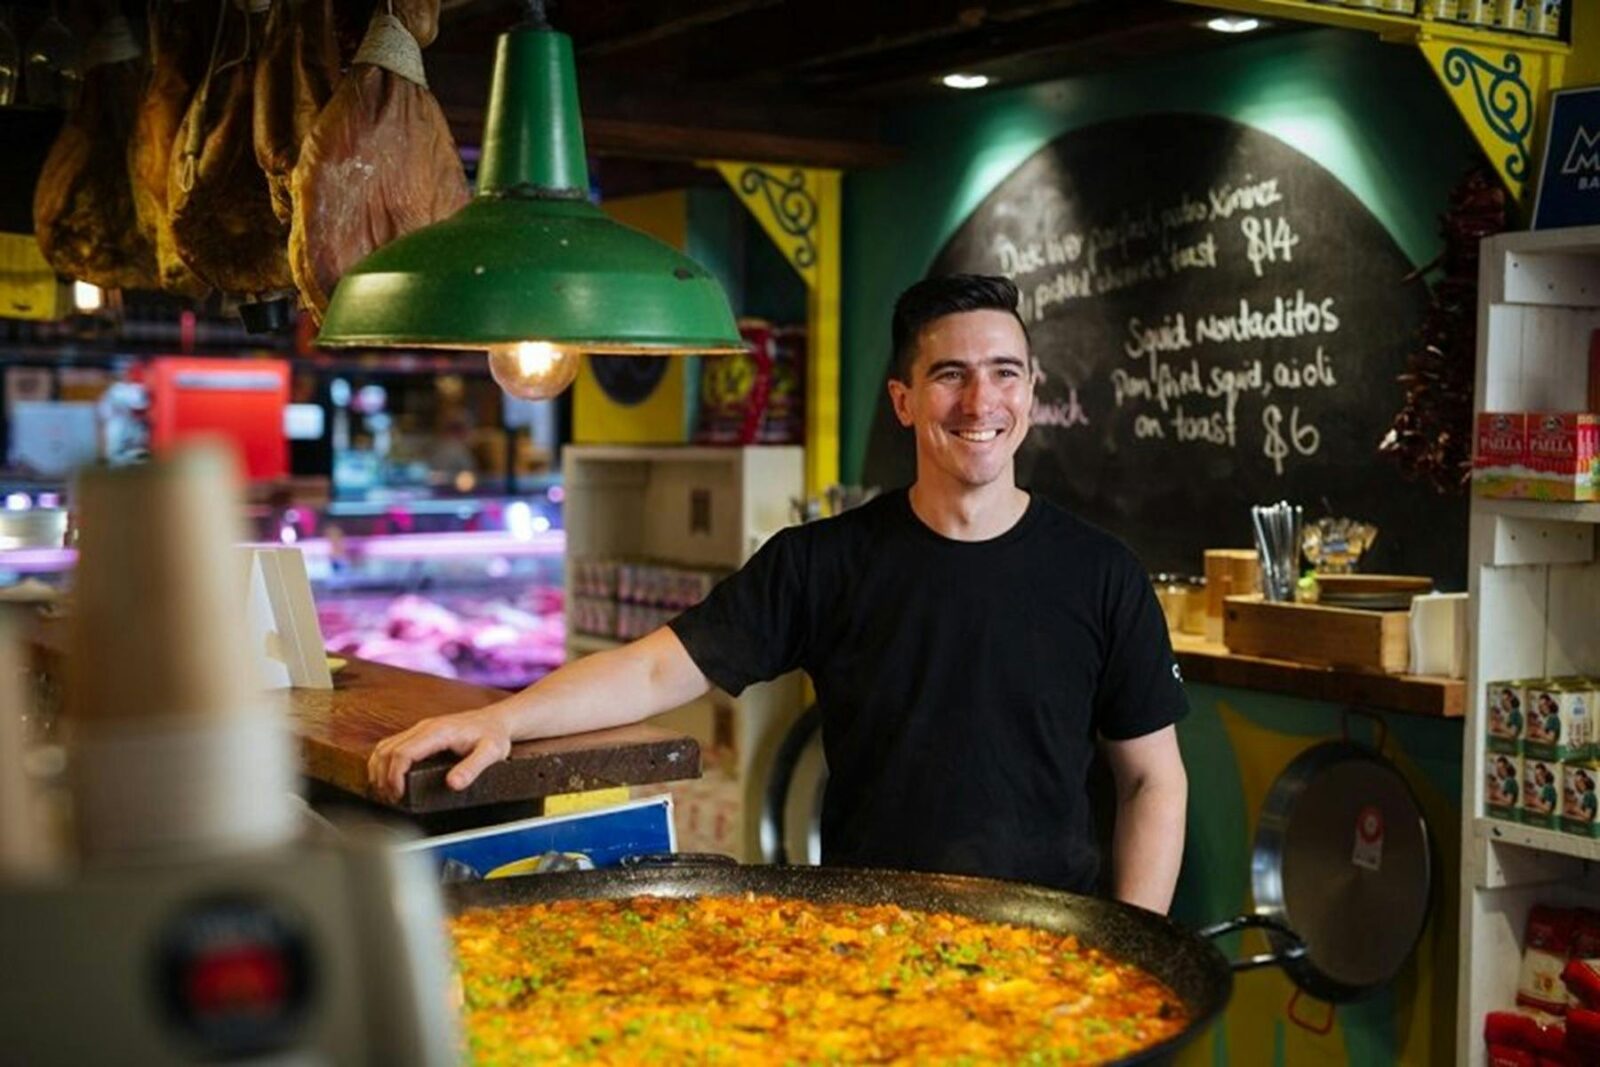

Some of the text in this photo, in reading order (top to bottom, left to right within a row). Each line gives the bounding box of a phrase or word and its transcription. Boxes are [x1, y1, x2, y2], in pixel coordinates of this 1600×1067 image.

[1241, 215, 1300, 277] $14
[1134, 403, 1321, 475] on toast $6
